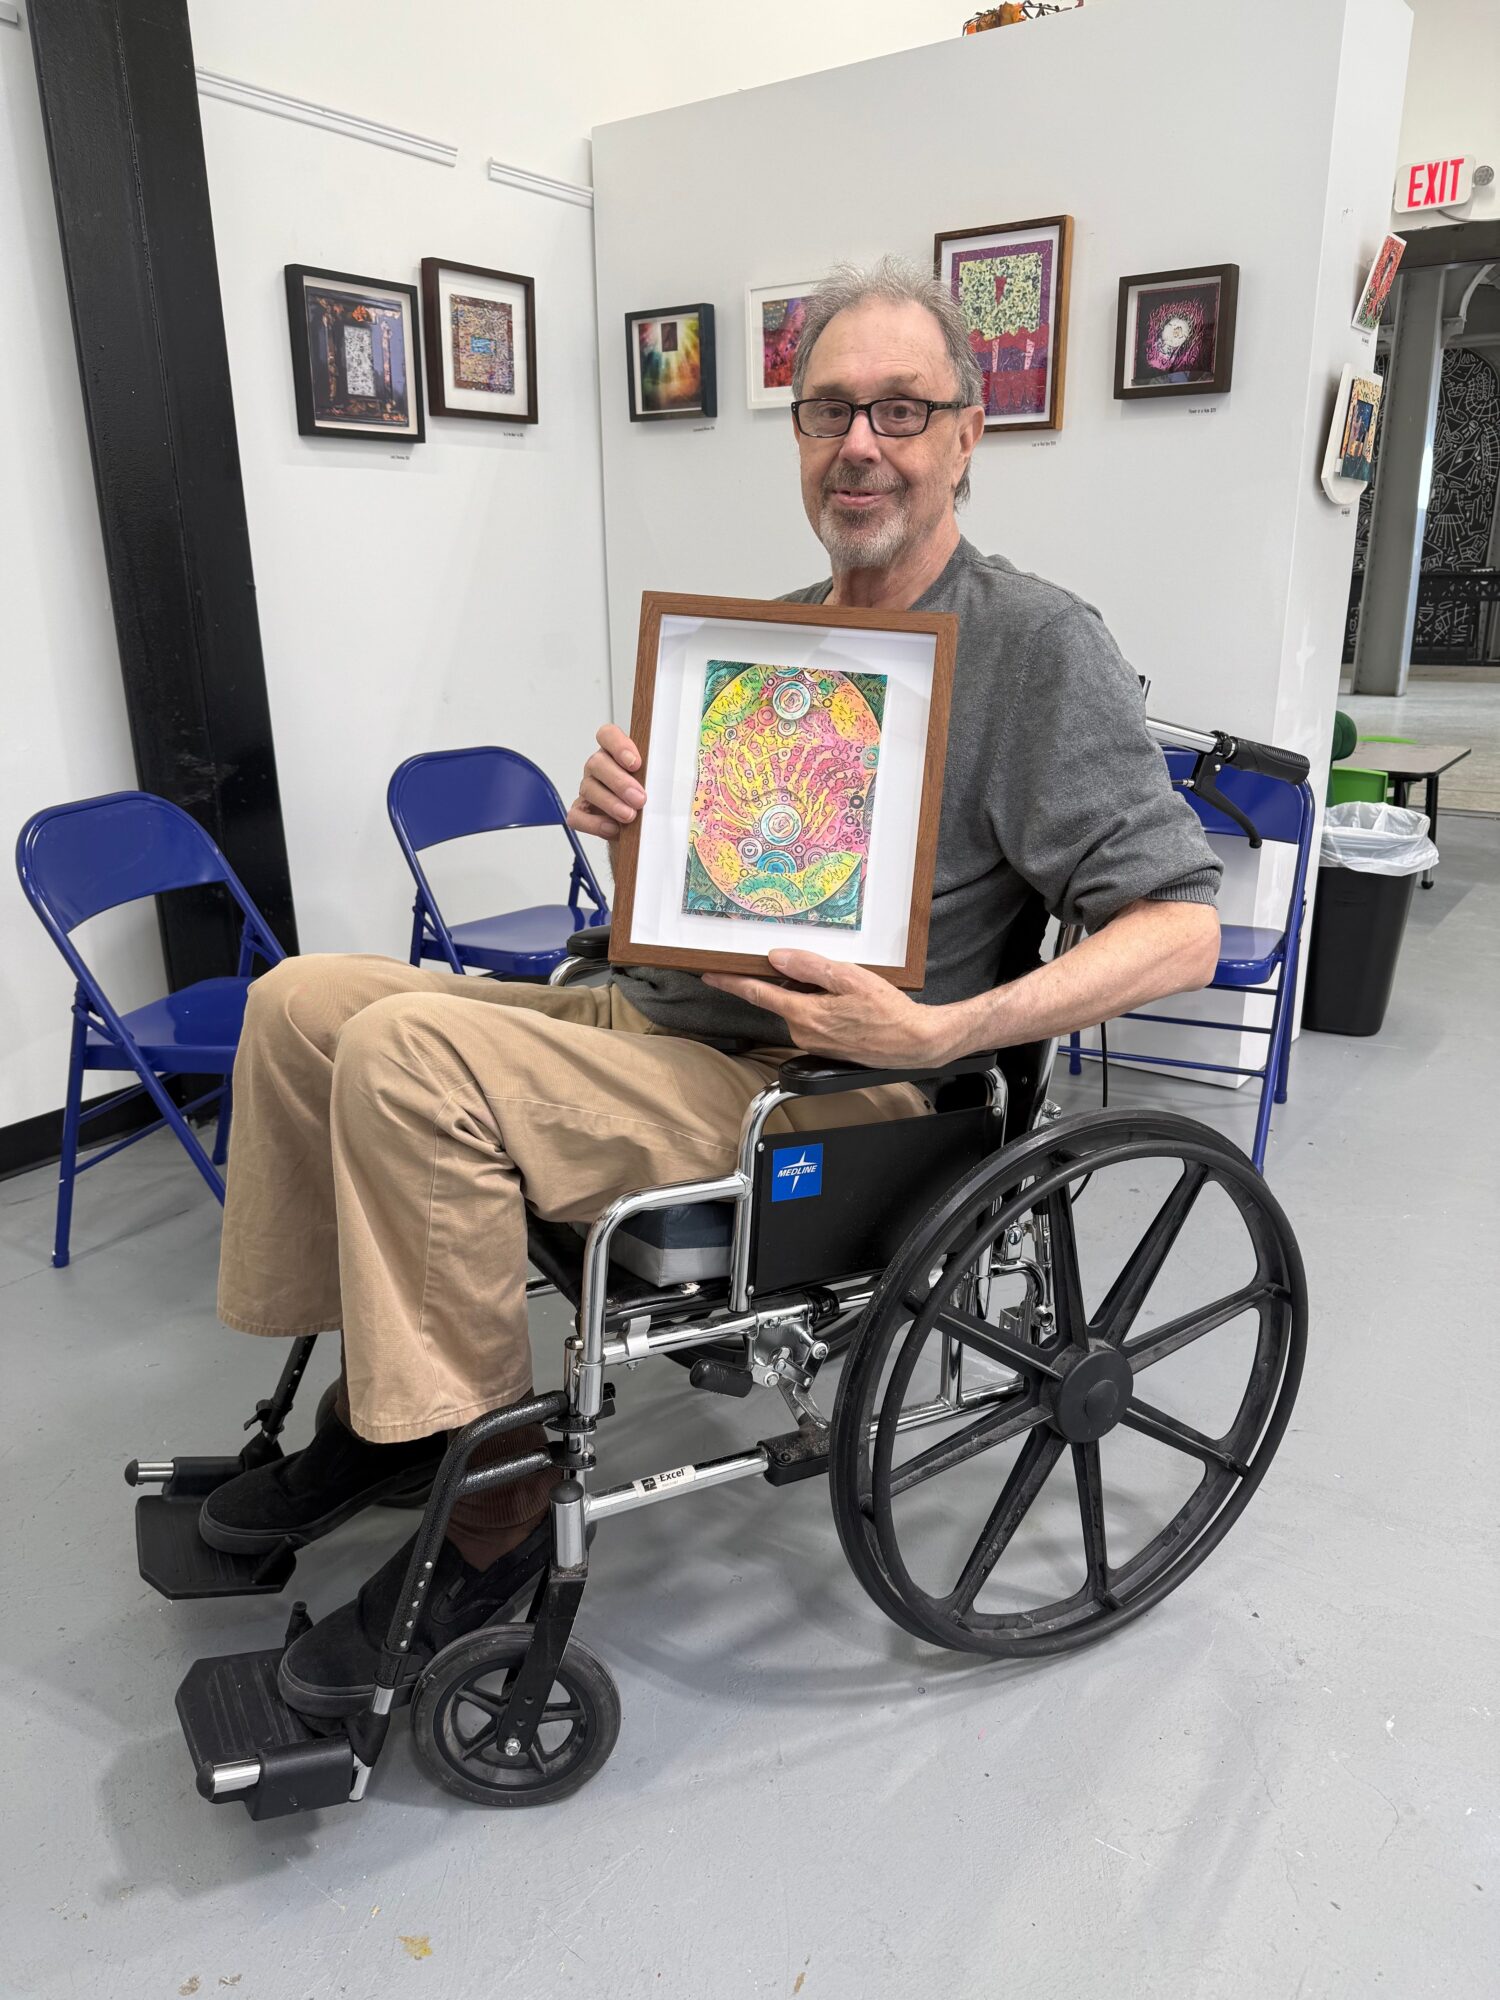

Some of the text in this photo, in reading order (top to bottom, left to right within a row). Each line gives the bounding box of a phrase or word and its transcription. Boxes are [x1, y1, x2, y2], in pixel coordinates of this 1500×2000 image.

[1407, 157, 1465, 208] EXIT
[777, 1164, 818, 1178] MEDLINE
[659, 1468, 685, 1482] Excel
